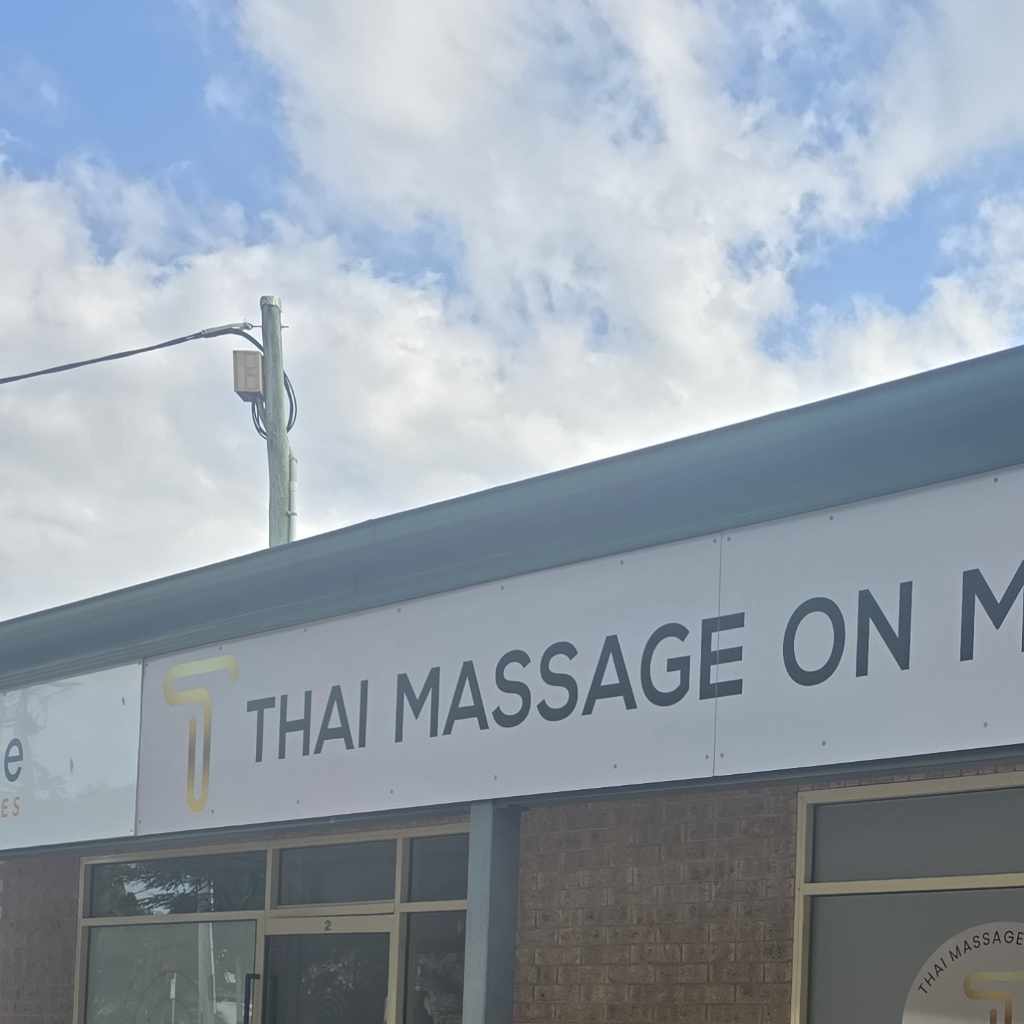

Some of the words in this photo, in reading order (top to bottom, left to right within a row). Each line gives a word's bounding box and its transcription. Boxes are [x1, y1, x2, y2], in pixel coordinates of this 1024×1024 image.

[246, 680, 368, 763] THAI
[394, 611, 746, 744] MASSAGE
[782, 580, 913, 687] ON
[323, 919, 332, 932] 2
[918, 957, 947, 995] THAI
[949, 929, 1024, 961] MASSAGE
